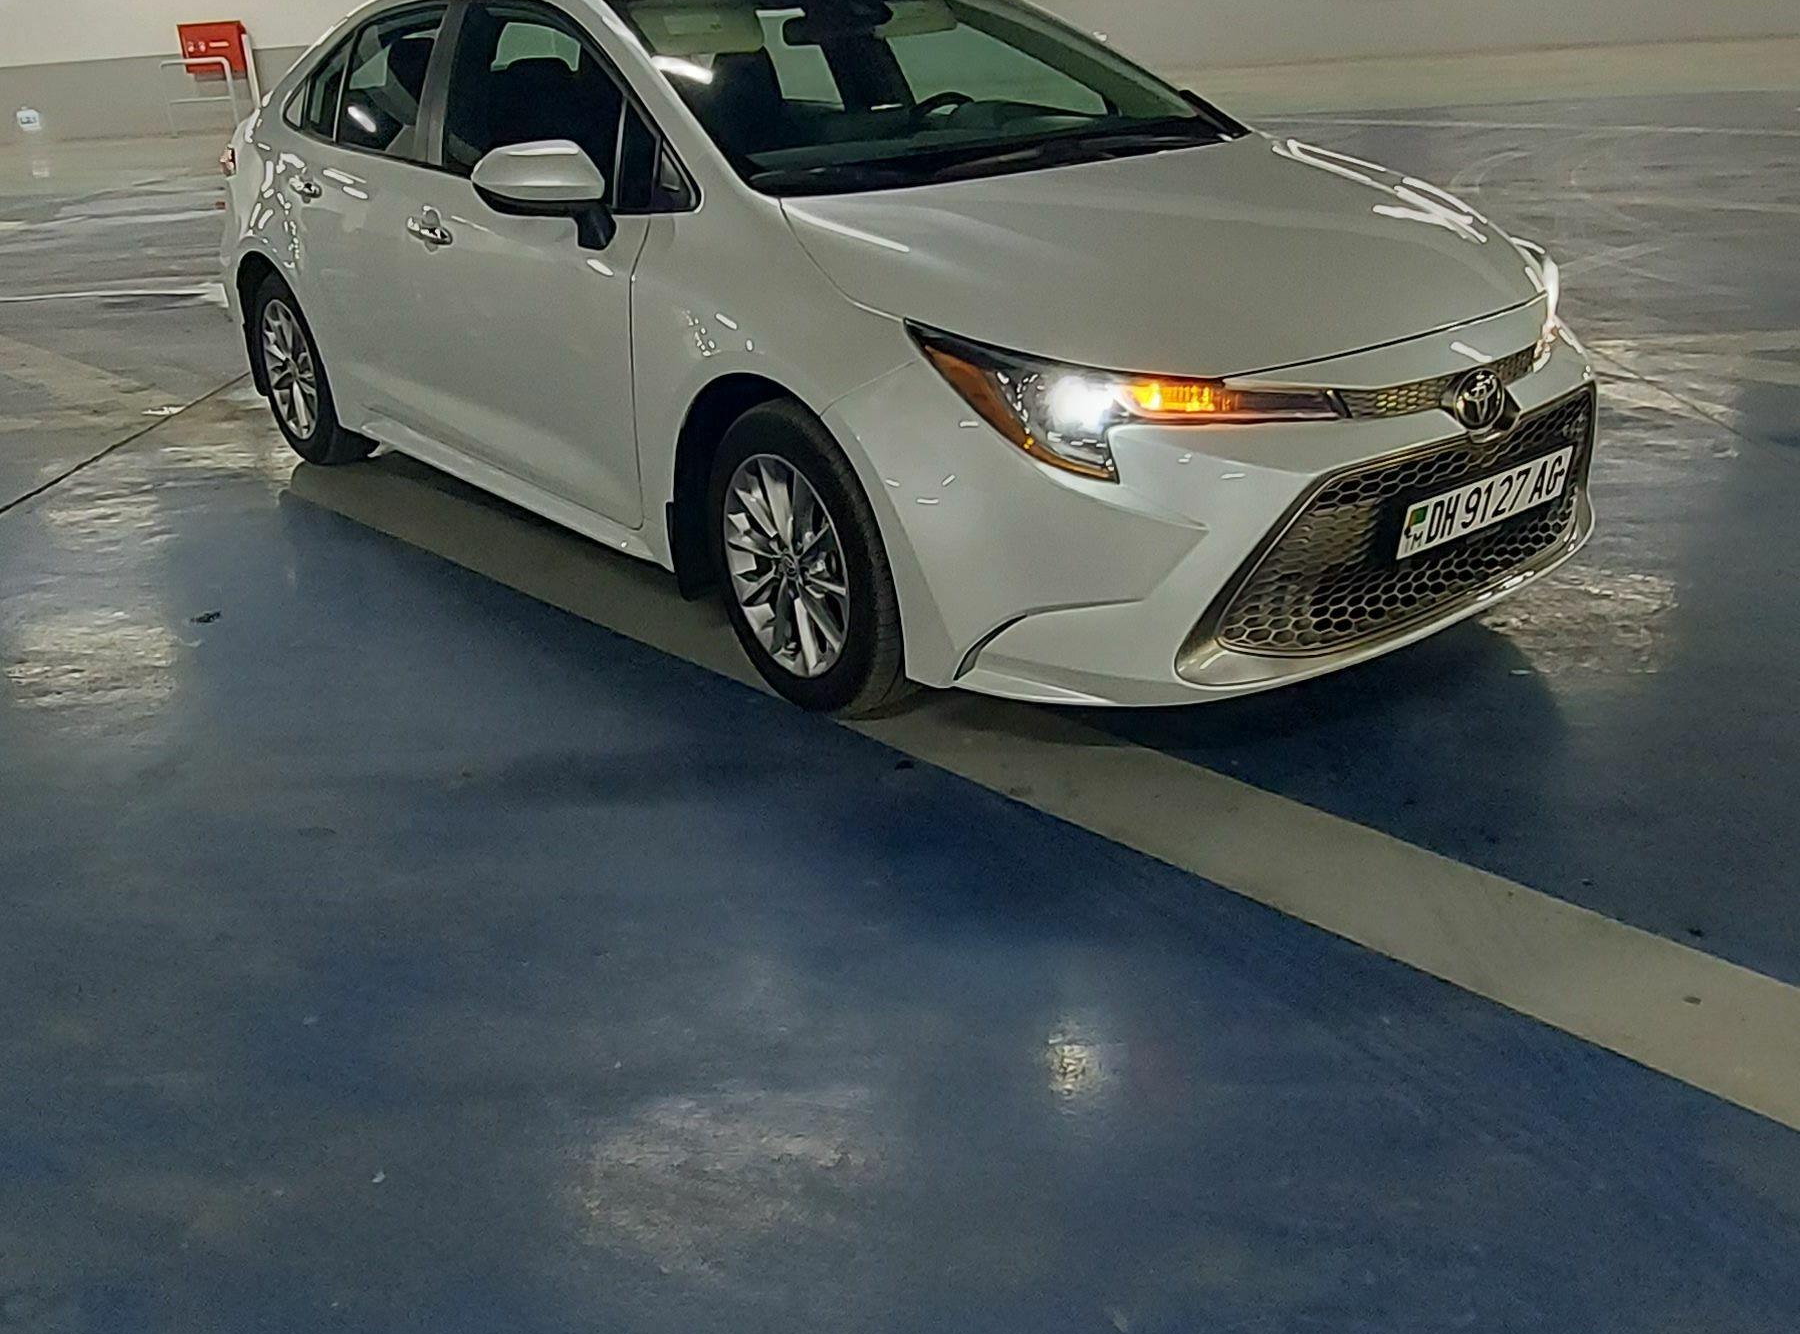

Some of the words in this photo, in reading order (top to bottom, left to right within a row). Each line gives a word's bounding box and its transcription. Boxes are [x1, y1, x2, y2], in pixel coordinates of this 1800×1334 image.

[1425, 493, 1461, 544] DH
[1461, 466, 1532, 529] 9127
[1528, 455, 1565, 504] AG
